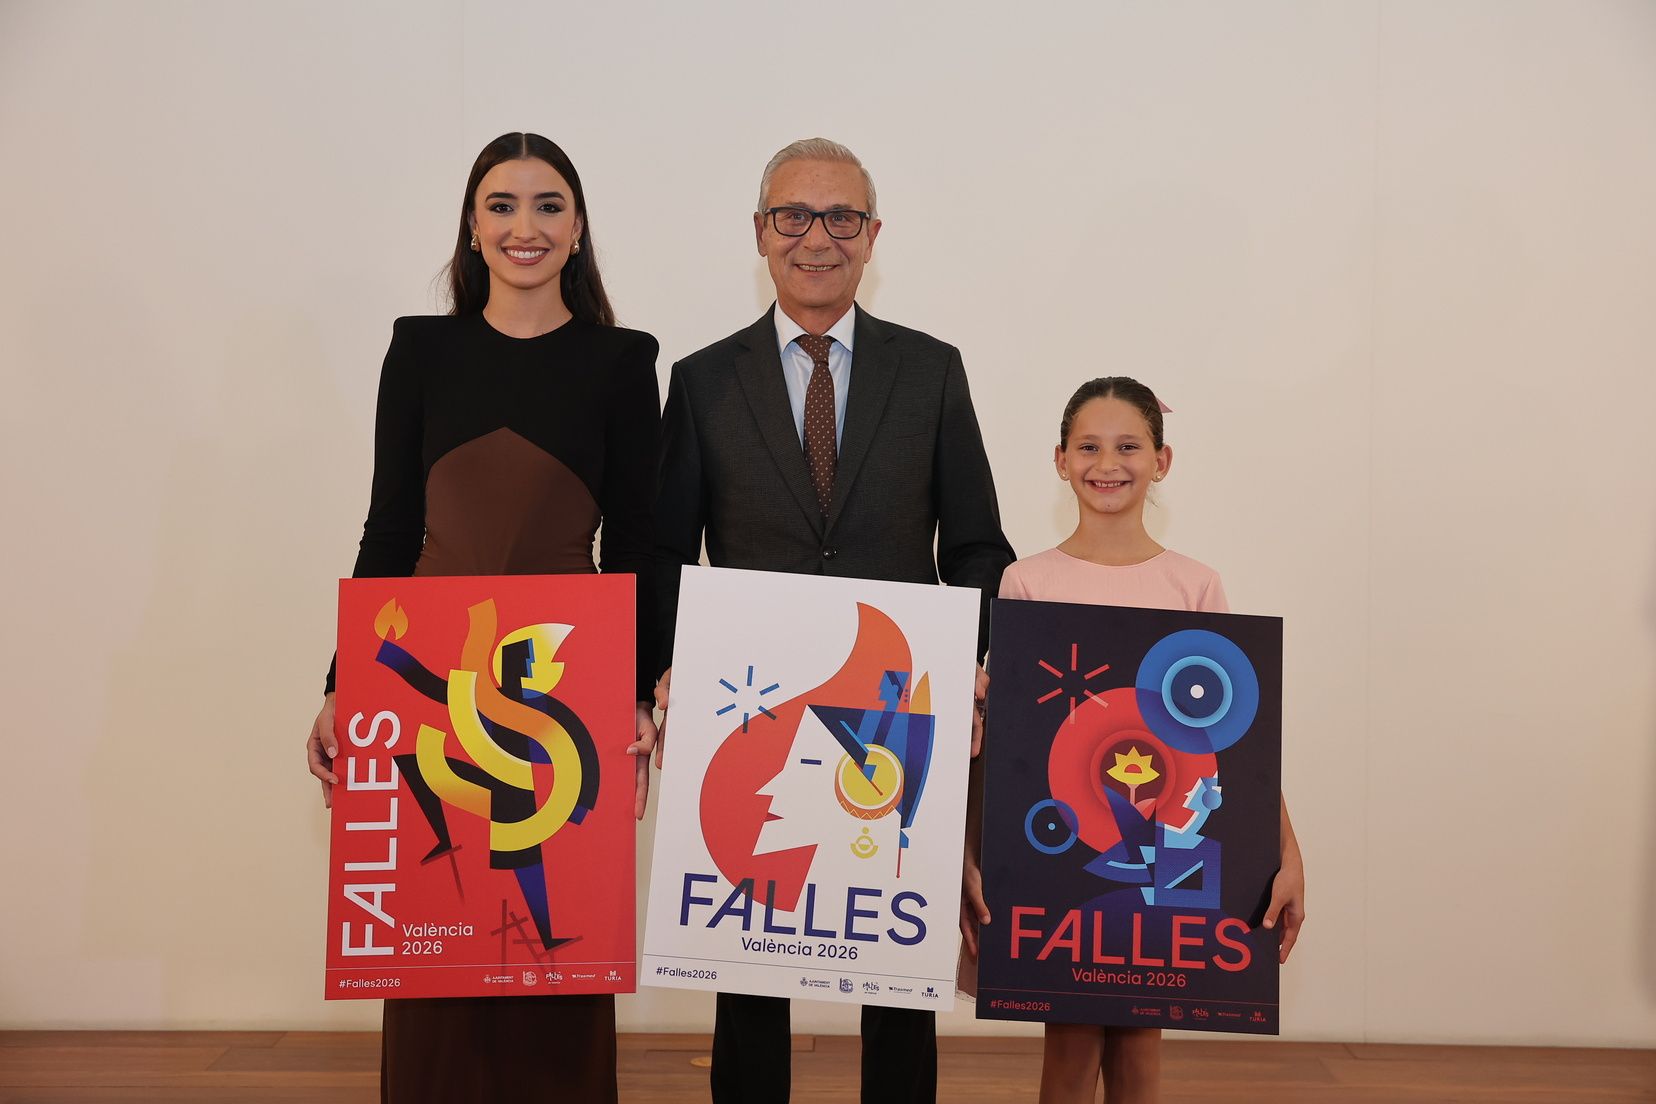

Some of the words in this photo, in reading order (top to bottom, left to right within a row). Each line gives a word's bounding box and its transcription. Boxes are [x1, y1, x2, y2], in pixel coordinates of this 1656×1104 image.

[342, 710, 401, 957] FALLES
[680, 872, 928, 946] FALLES
[402, 923, 474, 938] València
[1010, 905, 1252, 972] FALLES
[402, 941, 443, 955] 2026
[741, 937, 812, 957] València
[817, 943, 858, 960] 2026
[656, 966, 717, 980] #Falles2026
[1072, 967, 1142, 985] València
[1147, 971, 1186, 988] 2026
[339, 977, 401, 989] #Falles2026
[990, 999, 1050, 1012] #Falles2026
